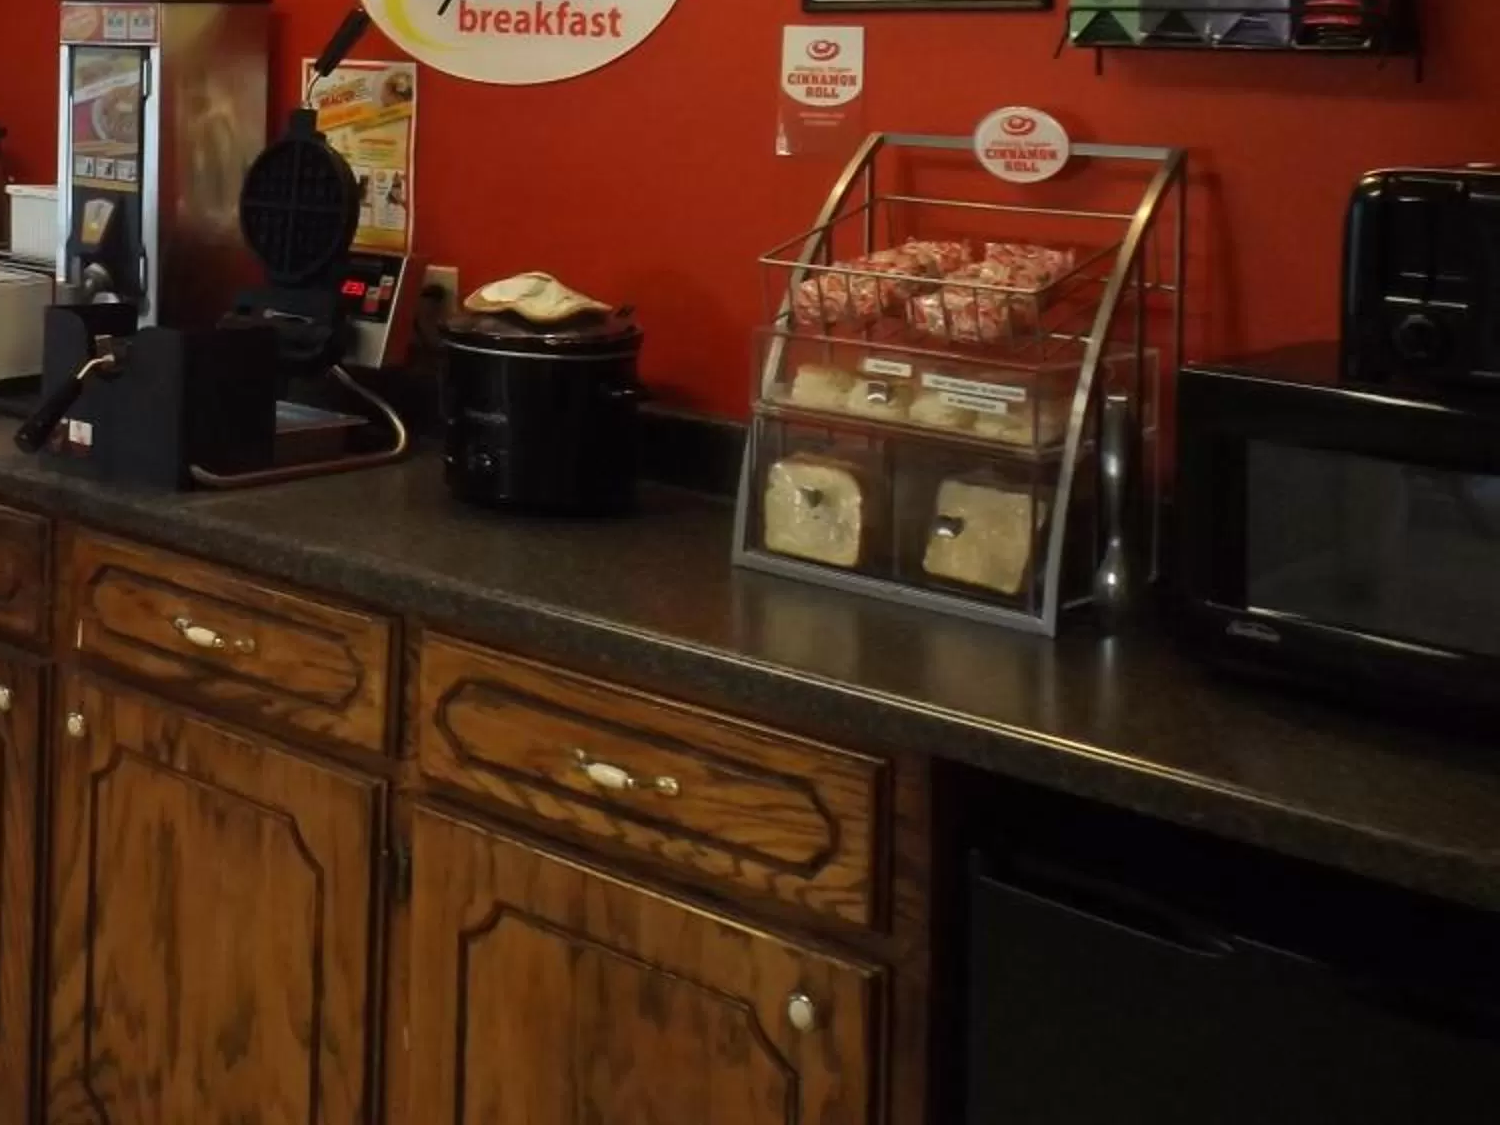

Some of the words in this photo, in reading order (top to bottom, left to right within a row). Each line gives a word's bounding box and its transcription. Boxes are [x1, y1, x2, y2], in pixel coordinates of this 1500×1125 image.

[458, 0, 622, 37] breakfast
[787, 73, 857, 86] CINNAMON
[805, 86, 839, 98] ROLL
